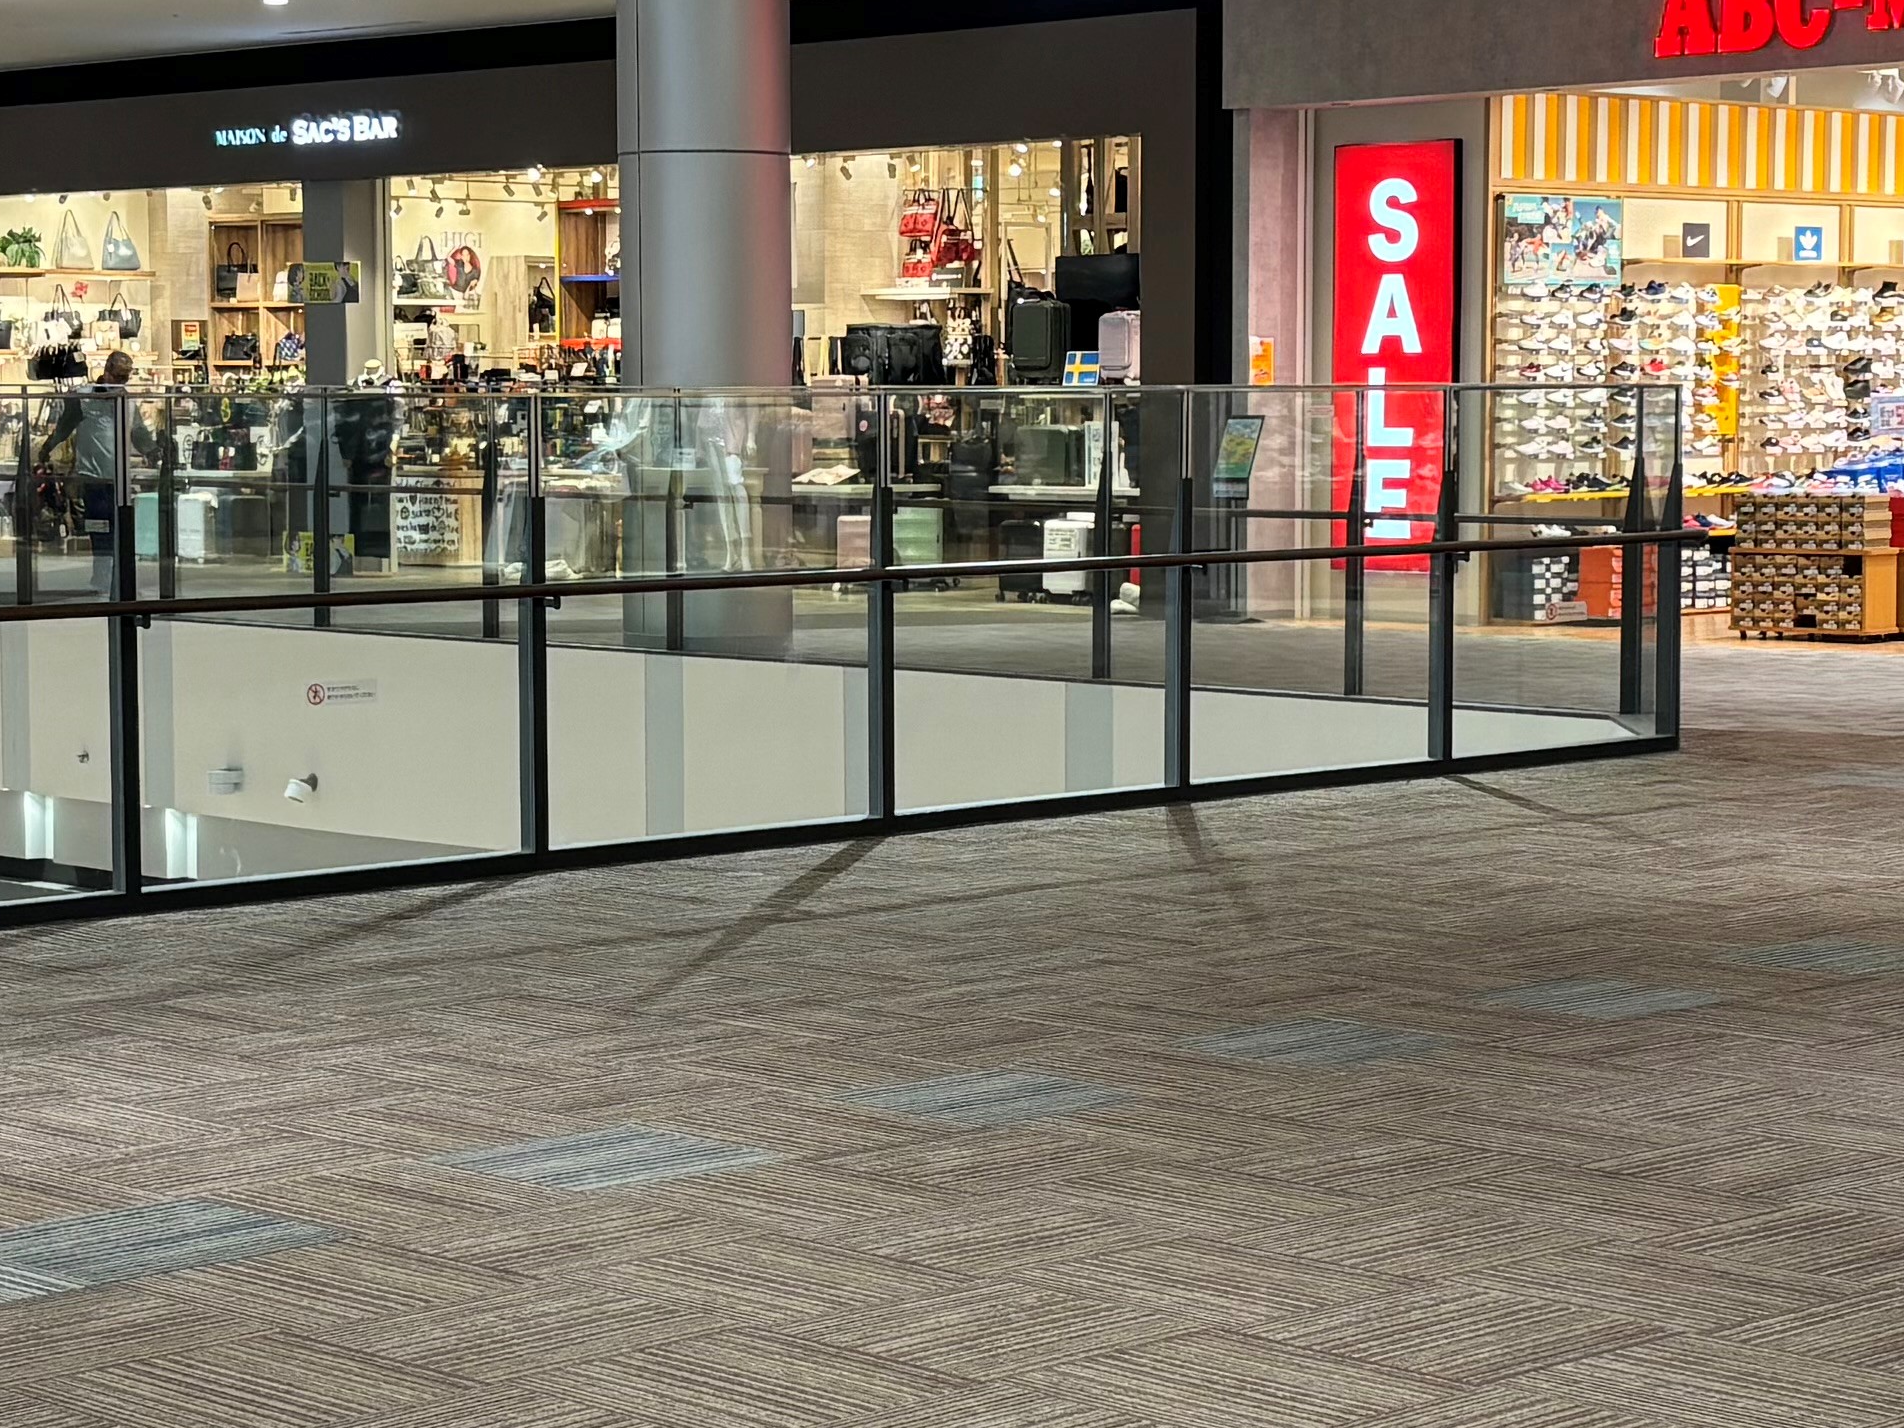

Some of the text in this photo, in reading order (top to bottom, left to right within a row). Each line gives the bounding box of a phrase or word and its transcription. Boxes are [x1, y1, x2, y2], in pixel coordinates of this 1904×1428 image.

[215, 115, 398, 147] MAISON de SAC'S BAR
[1361, 177, 1422, 539] SALE
